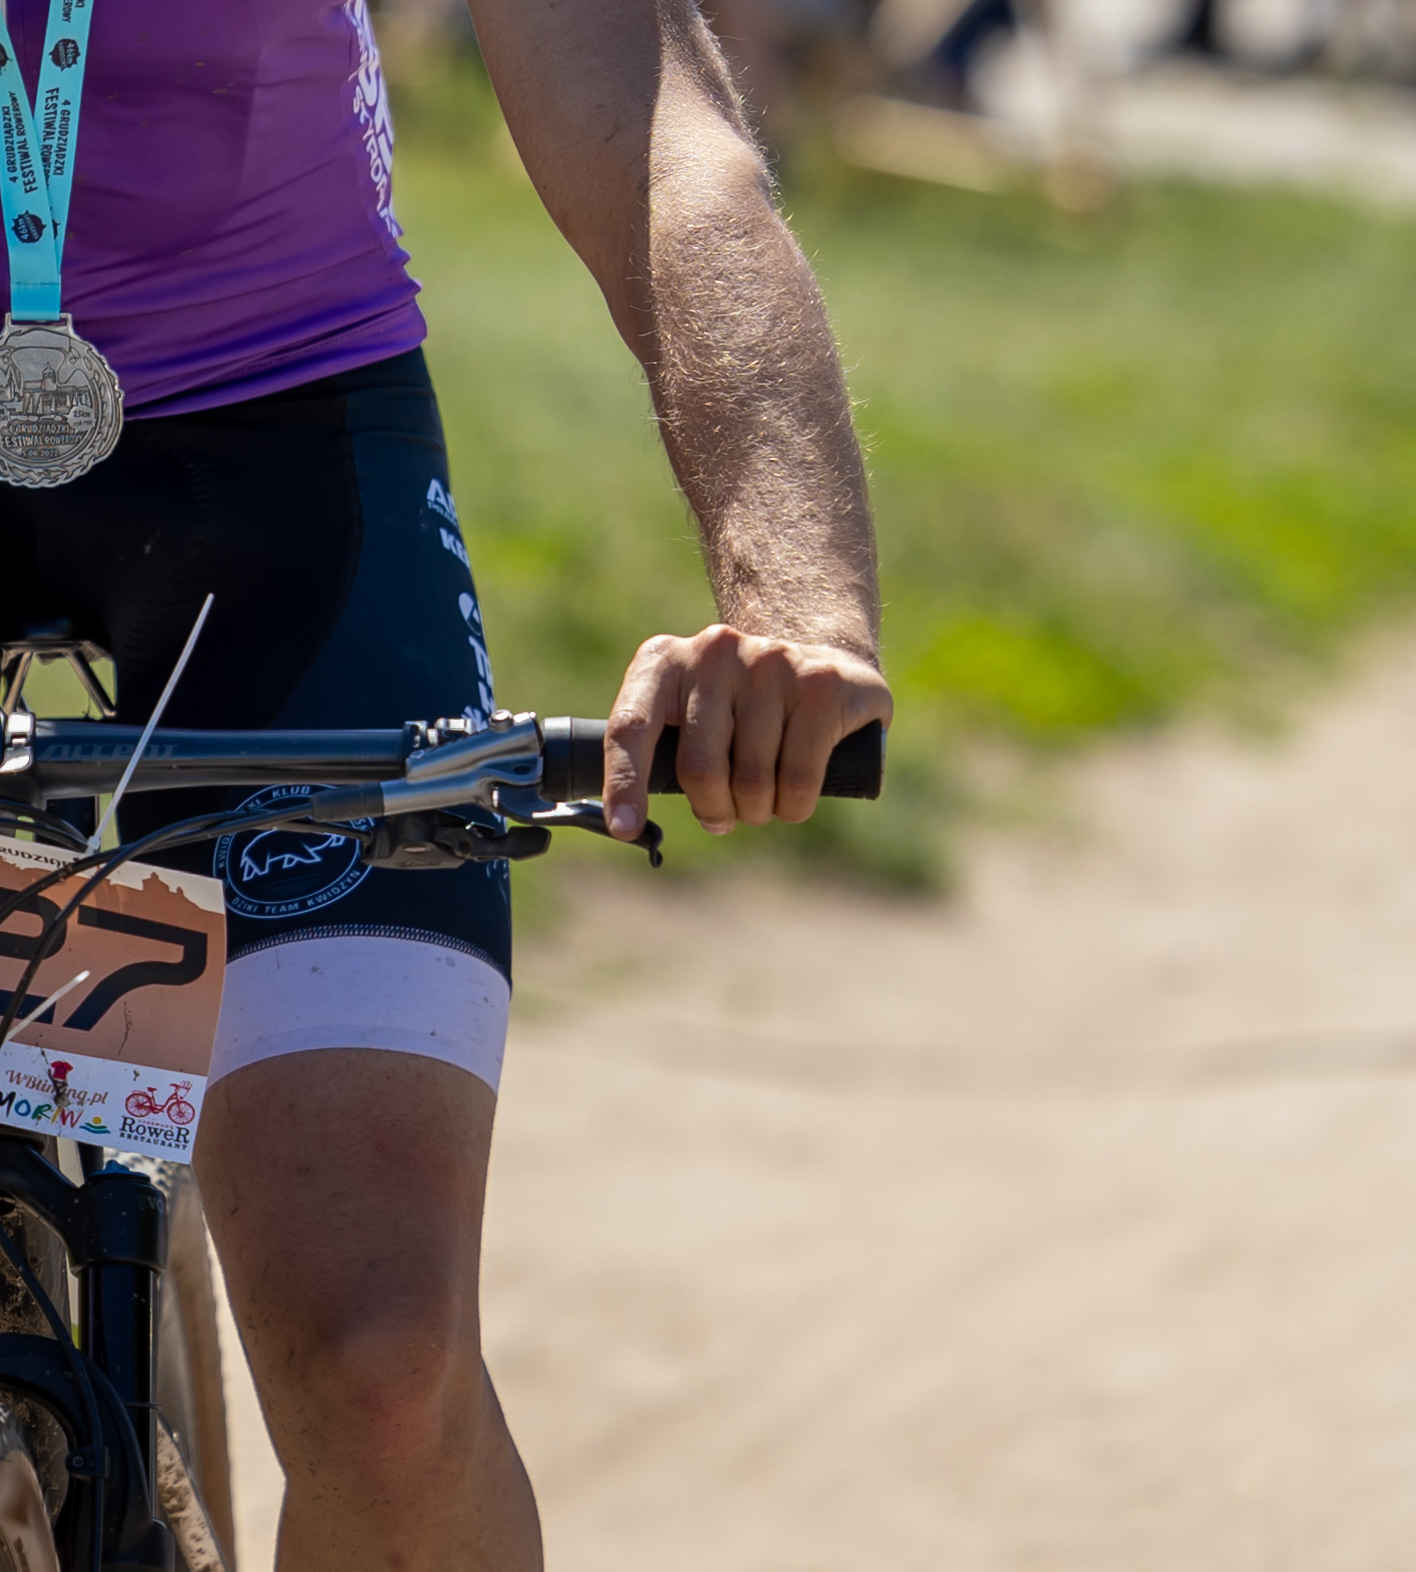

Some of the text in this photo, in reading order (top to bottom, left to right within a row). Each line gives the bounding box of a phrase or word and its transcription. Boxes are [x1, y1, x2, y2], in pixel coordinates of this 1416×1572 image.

[8, 90, 26, 137] ROWEROWY
[42, 87, 60, 142] FESTIWAL
[53, 109, 71, 176] GRUDZIĄDZKI
[9, 175, 19, 183] 4
[16, 138, 39, 194] FESTIWAL
[0, 434, 43, 448] FESTIWAL
[271, 785, 311, 798] KLUB
[264, 902, 300, 914] TEAM
[307, 869, 361, 906] KWIDZYN
[119, 1131, 188, 1151] RESTAURANT
